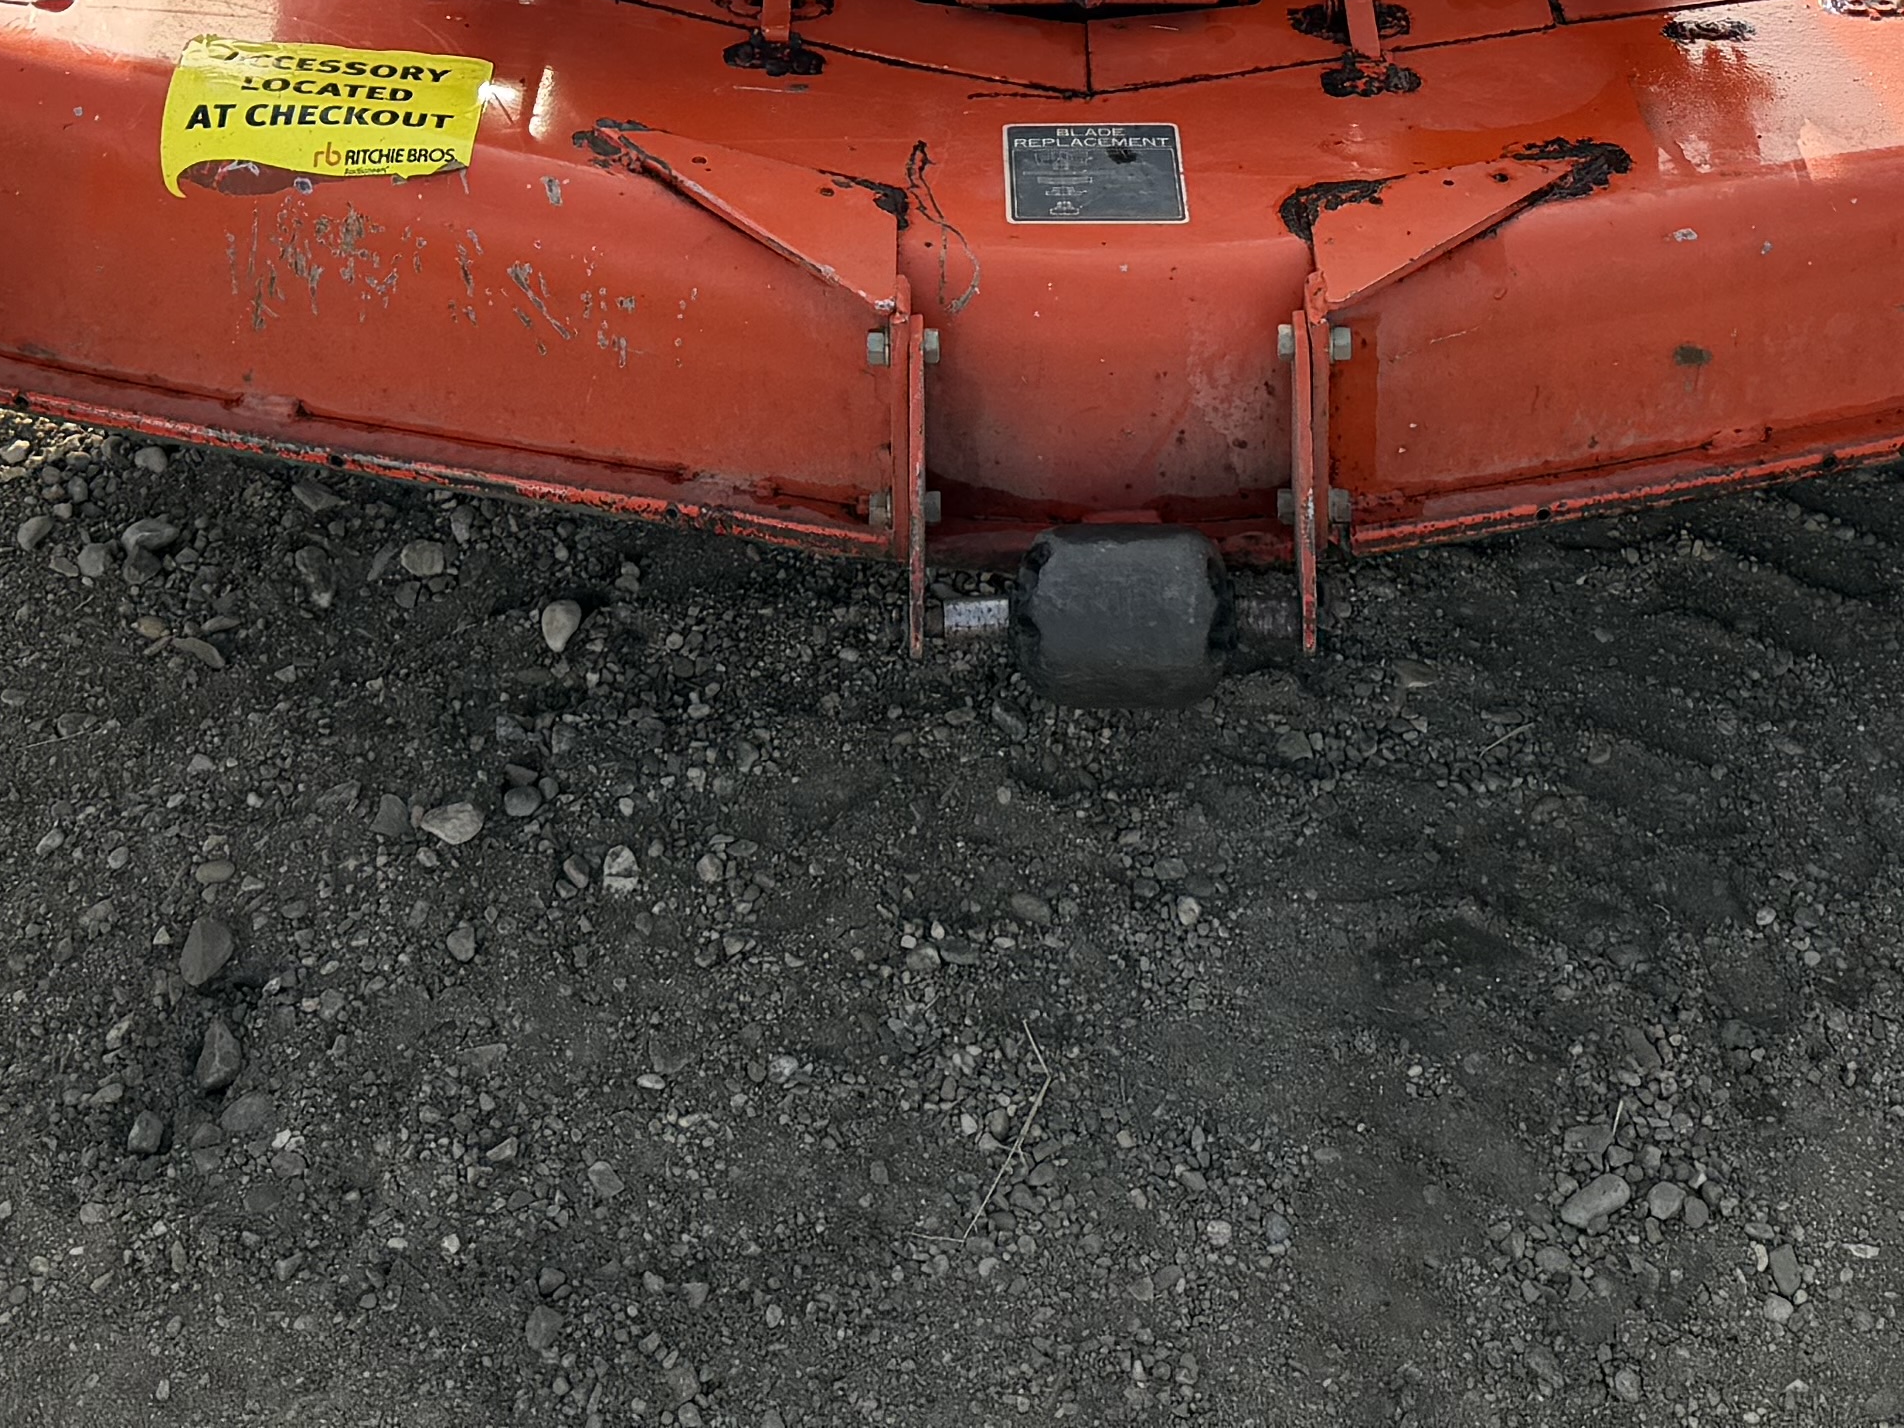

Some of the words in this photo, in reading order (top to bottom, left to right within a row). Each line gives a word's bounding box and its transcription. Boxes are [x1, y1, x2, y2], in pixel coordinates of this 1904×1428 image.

[241, 76, 415, 102] LOCATED
[185, 103, 238, 130] AT
[245, 103, 455, 130] CHECKOUT
[1056, 127, 1126, 137] BLADE
[1013, 137, 1171, 148] REPLACEMENT
[345, 148, 405, 166] RITCHIE
